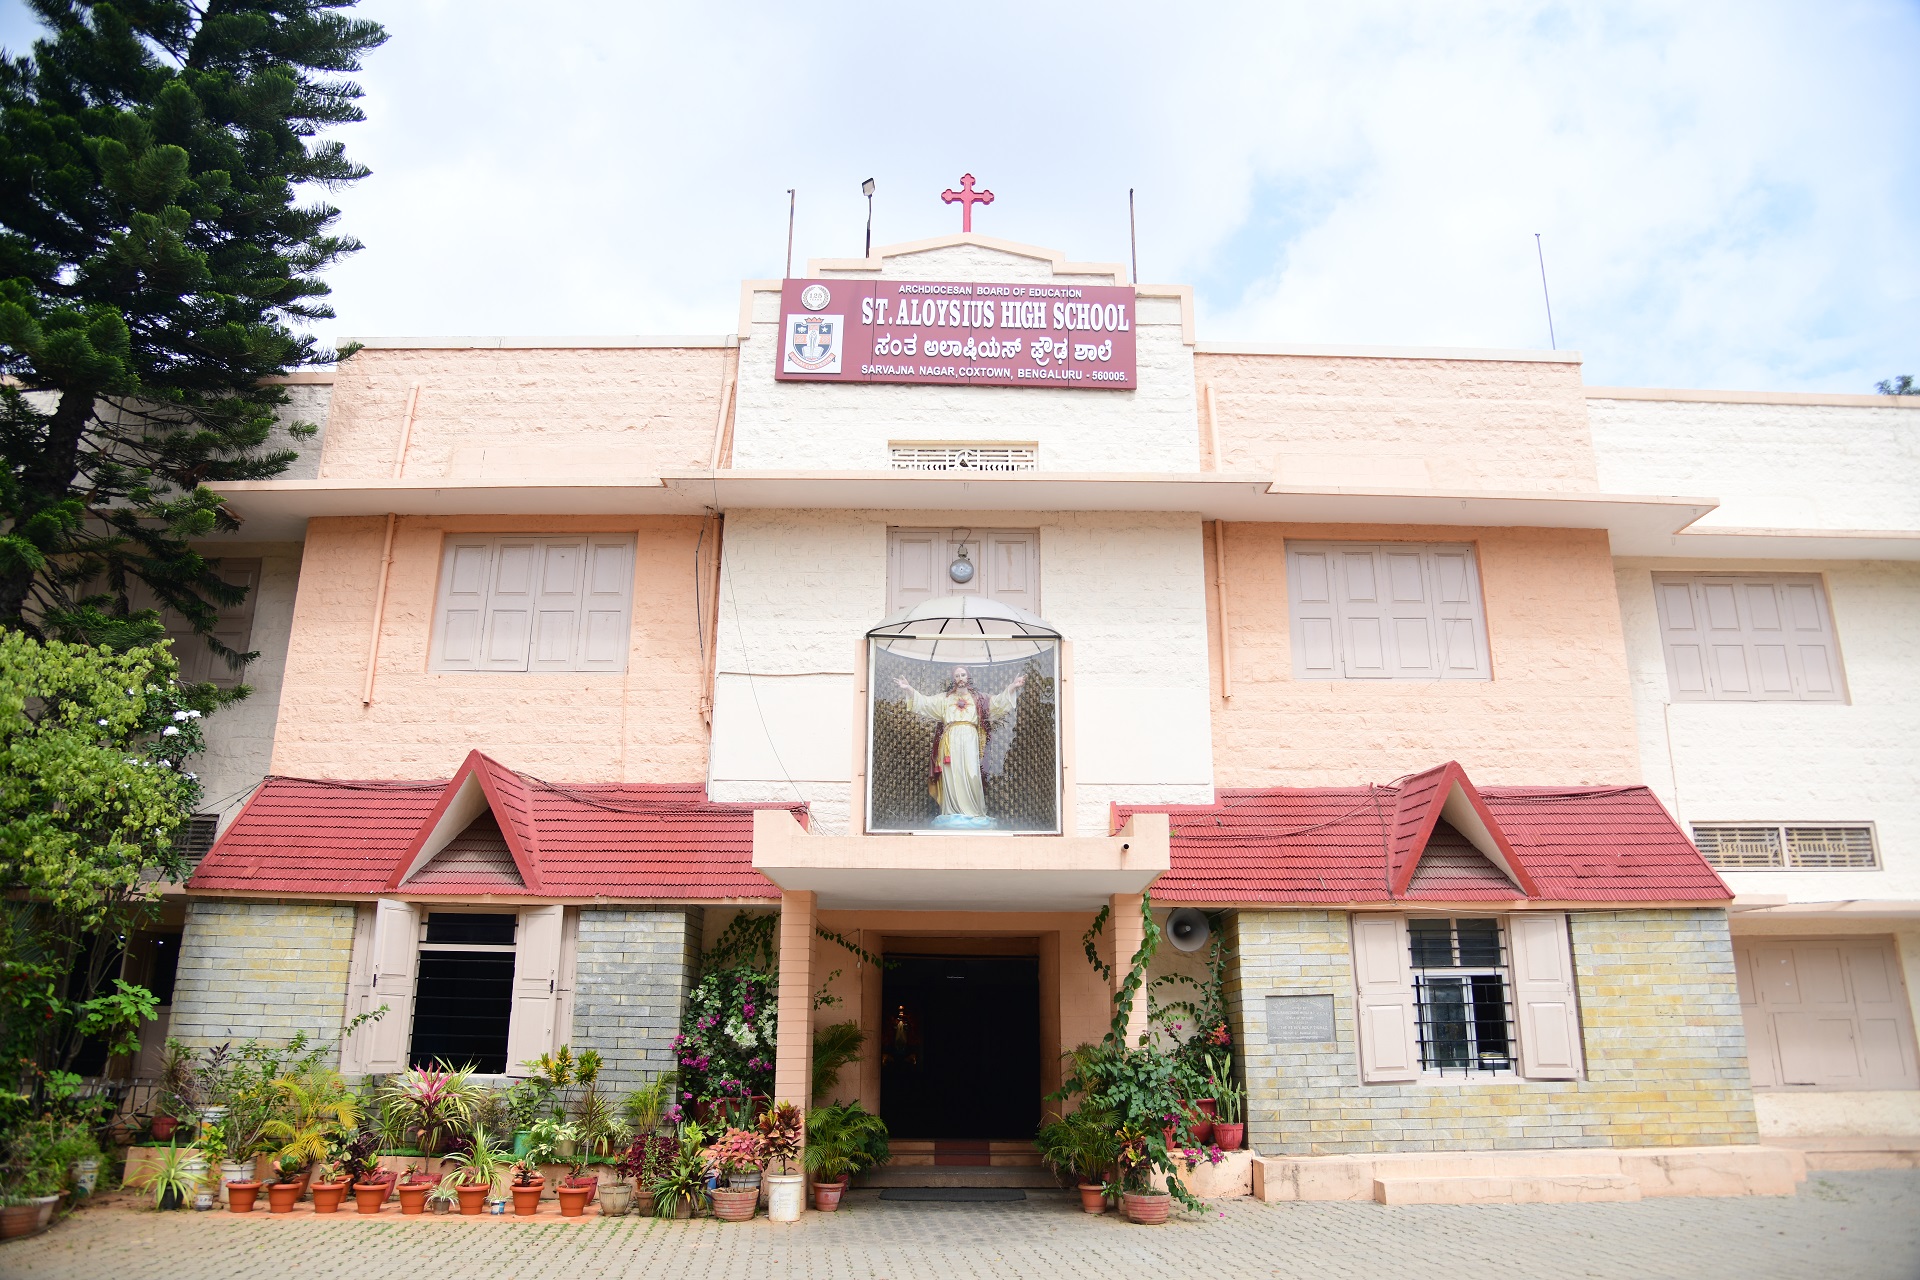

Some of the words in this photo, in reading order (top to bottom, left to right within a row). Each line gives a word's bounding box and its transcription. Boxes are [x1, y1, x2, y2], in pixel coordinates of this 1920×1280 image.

[898, 285, 972, 295] ARCHDIOCESAN
[977, 286, 1010, 296] BOARD
[1012, 288, 1026, 296] OF
[1029, 288, 1082, 298] EDUCATION
[1000, 300, 1047, 328] HIGH
[1053, 302, 1129, 331] SCHOOL
[875, 332, 918, 356] ಸಂತ
[1030, 336, 1068, 366] ಪ್ರೌಢ
[1074, 339, 1112, 362] ಶಾಲೆ
[862, 364, 914, 375] SARVAJNA
[1018, 369, 1082, 380] BENGALURU
